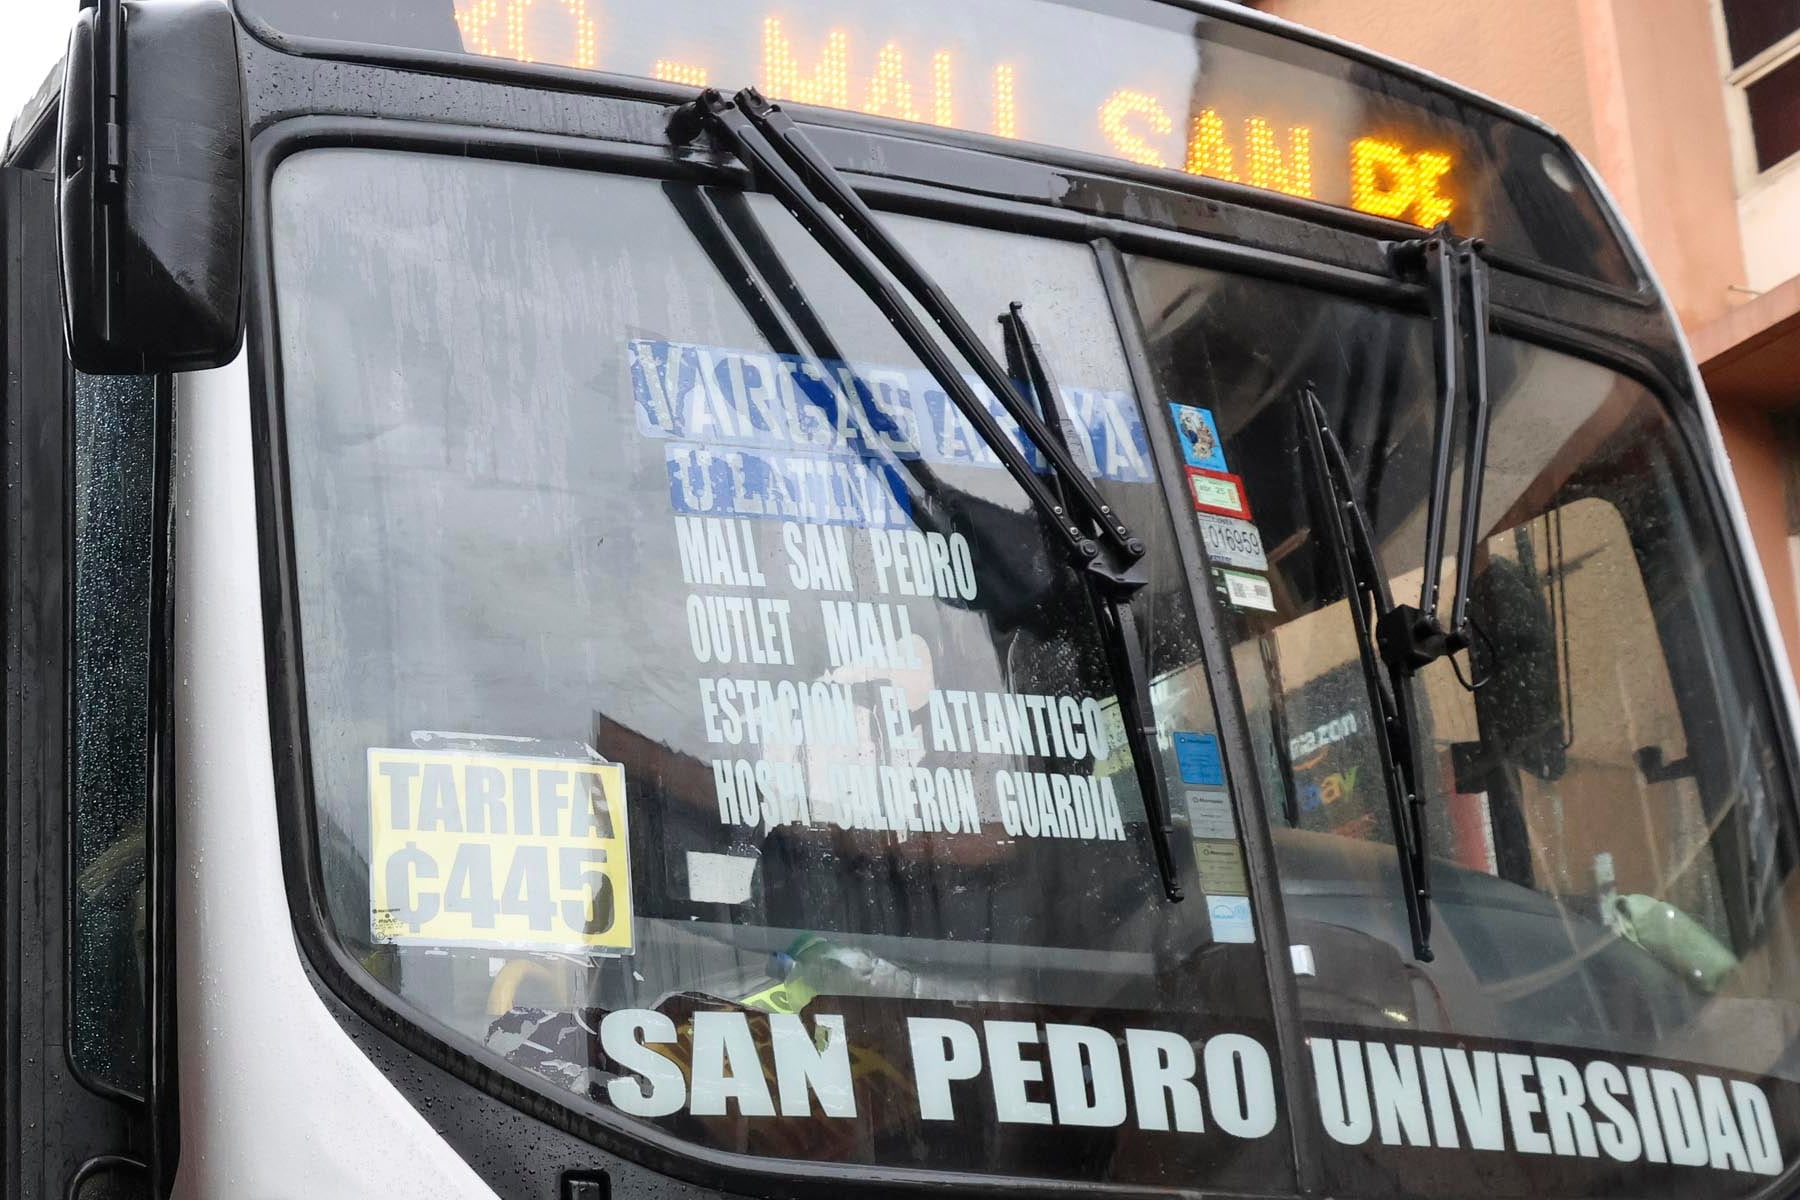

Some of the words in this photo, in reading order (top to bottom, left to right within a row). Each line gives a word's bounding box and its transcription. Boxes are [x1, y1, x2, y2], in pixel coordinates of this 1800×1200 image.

[640, 344, 920, 452] VARGAS
[674, 516, 766, 587] MALL
[782, 521, 853, 592] SAN
[871, 529, 978, 601] PEDRO
[1208, 525, 1261, 555] 016959
[687, 594, 795, 665] OUTLET
[821, 600, 921, 671] MALL
[880, 686, 921, 750] EL
[928, 689, 1109, 761] ATLANTICO
[379, 761, 616, 840] TARIFA
[828, 763, 982, 834] CALDERON
[996, 770, 1127, 842] GUARDIA
[599, 1008, 857, 1119] SAN
[907, 1015, 1278, 1139] PEDRO
[1308, 1037, 1784, 1176] UNIVERSIDAD
